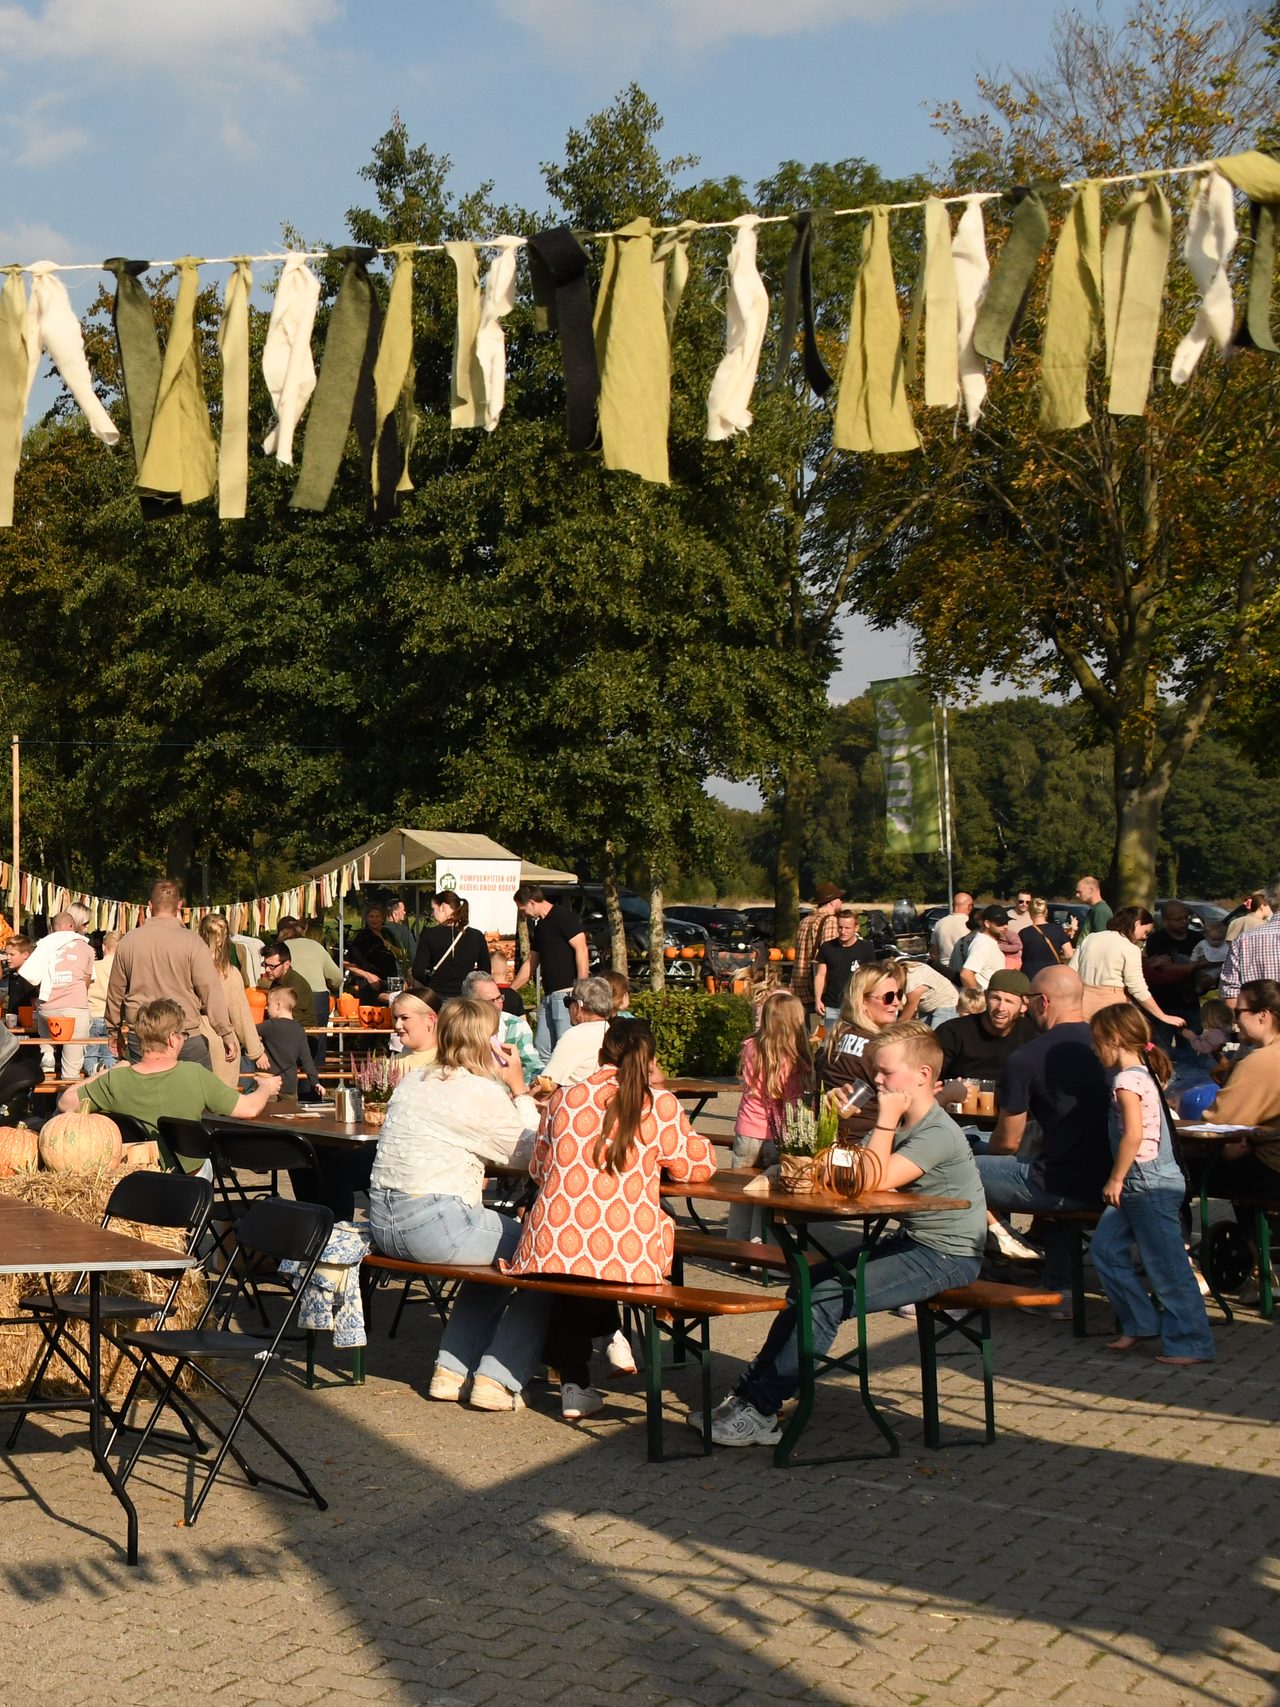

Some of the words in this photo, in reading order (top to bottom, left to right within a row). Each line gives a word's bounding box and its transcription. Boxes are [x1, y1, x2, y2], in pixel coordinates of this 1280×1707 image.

[506, 875, 516, 883] VAN
[459, 883, 496, 891] NEDERLANDSE
[498, 884, 516, 892] BODEM
